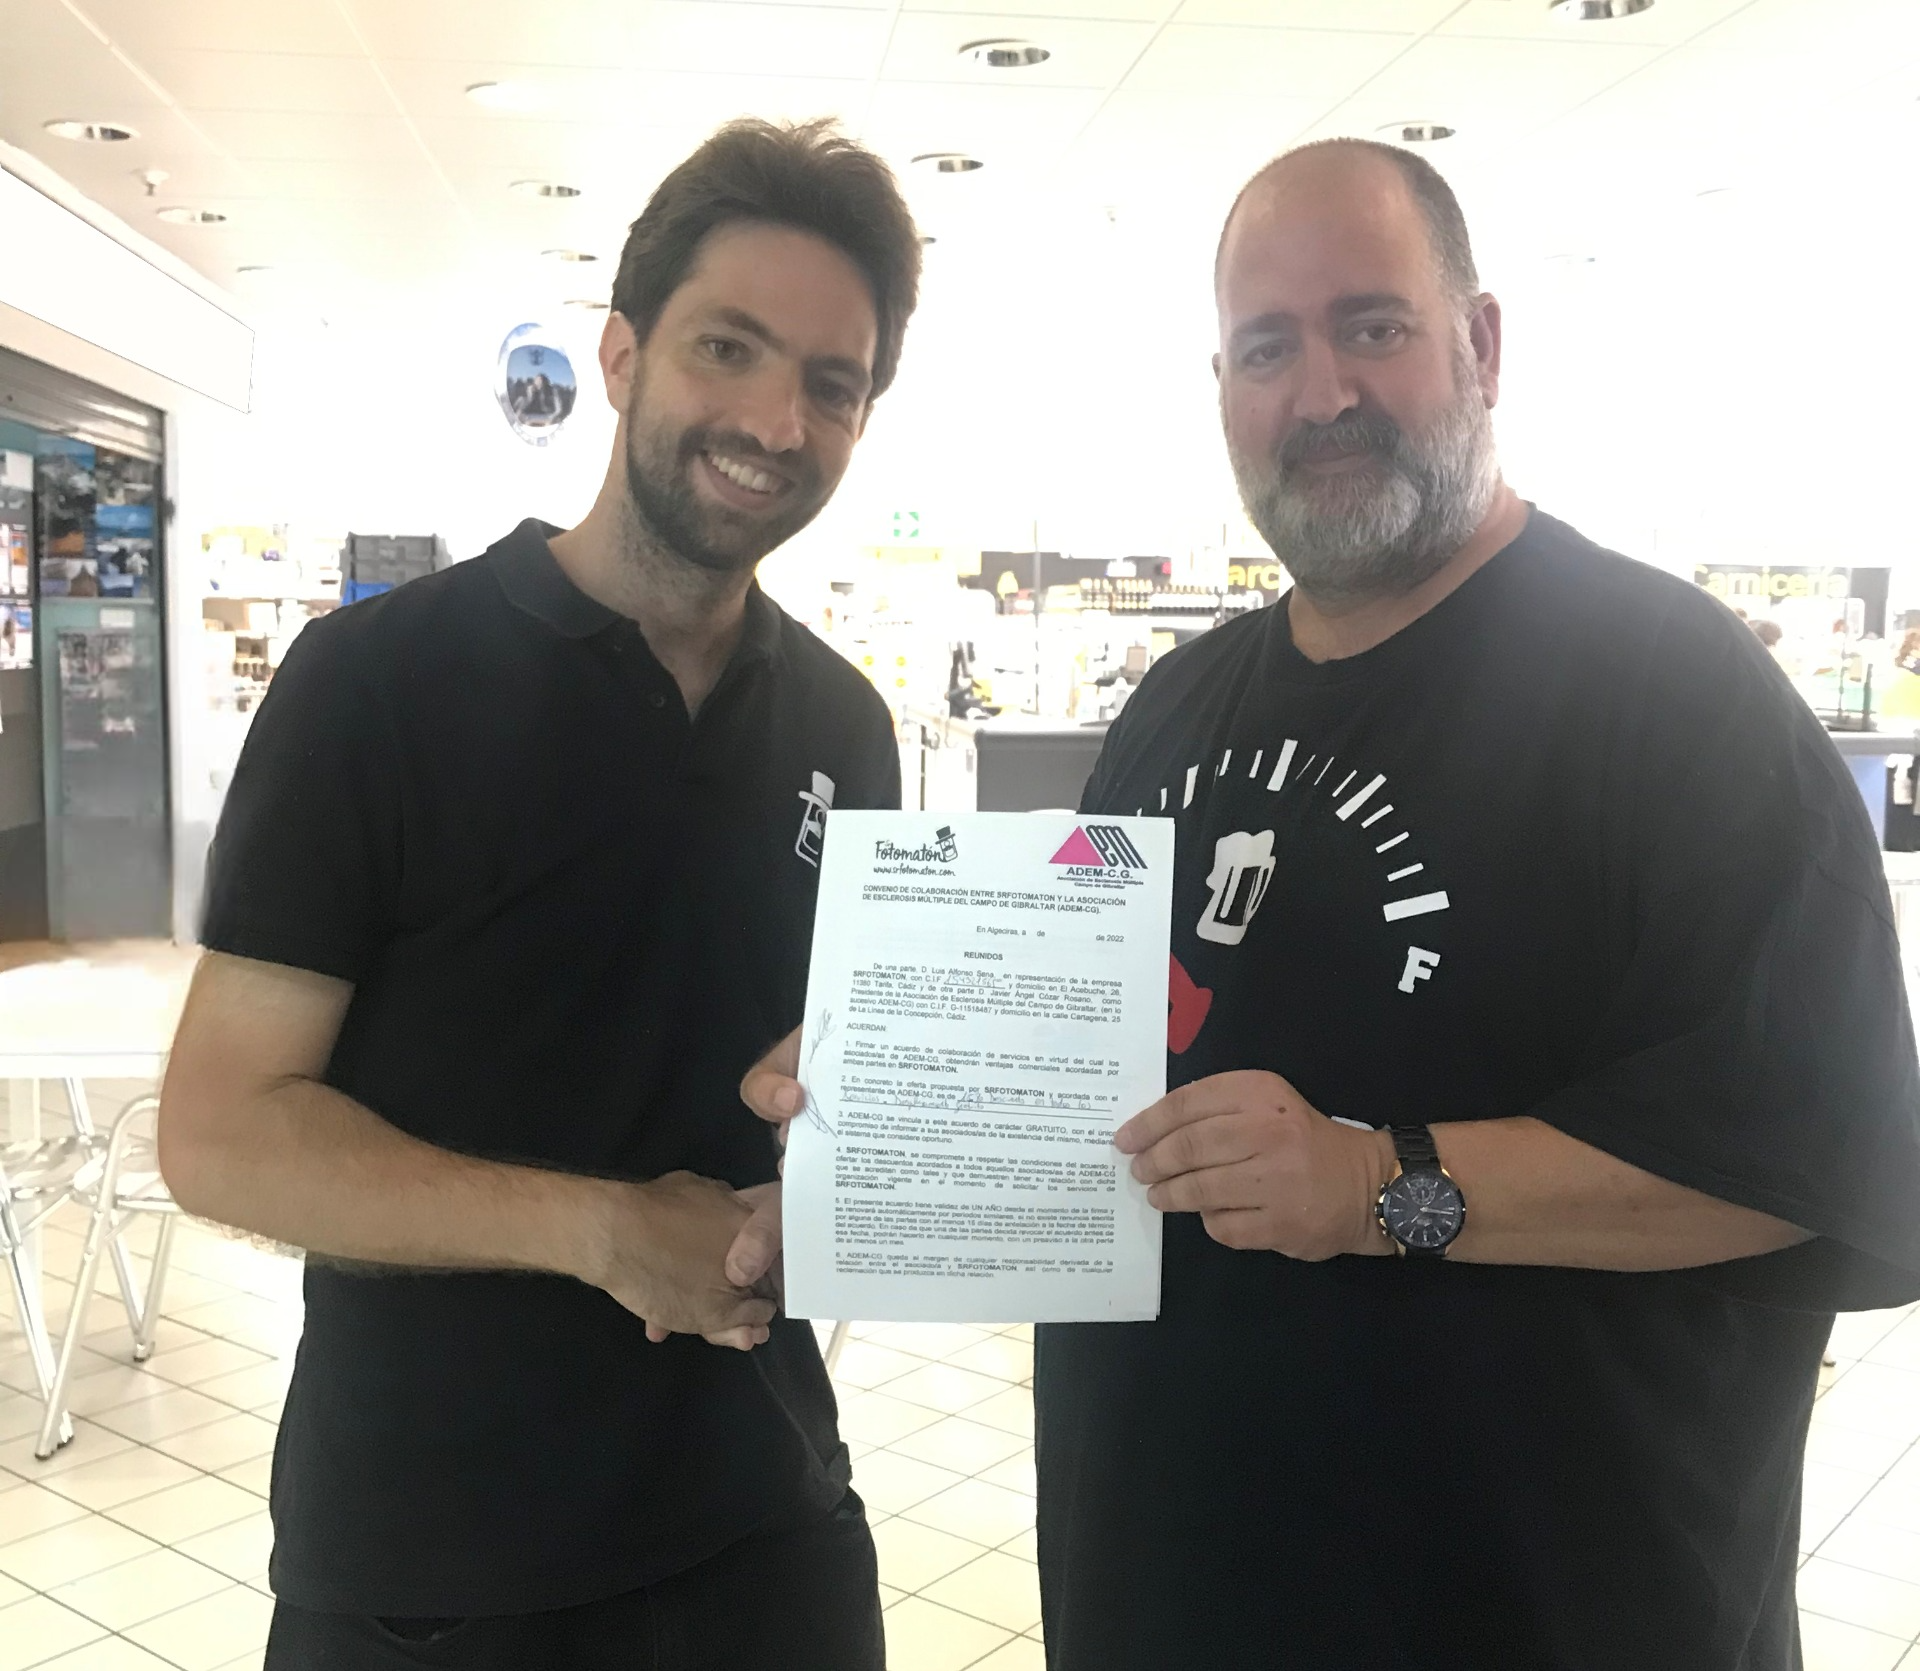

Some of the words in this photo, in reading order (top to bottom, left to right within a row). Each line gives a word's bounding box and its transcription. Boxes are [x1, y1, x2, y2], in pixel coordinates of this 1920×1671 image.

[876, 840, 943, 862] Fotomatón
[1066, 867, 1133, 879] ADEM-C.G.
[864, 885, 898, 893] CONVENIO
[911, 885, 968, 896] COLABORACIÓN
[970, 889, 994, 897] ENTRE
[997, 891, 1055, 901] SRFOTOMATON
[1077, 894, 1126, 905] ASOCIACIÓN
[873, 894, 916, 902] ESCLEROSIS
[917, 894, 952, 904] MÚLTIPLE
[970, 898, 997, 906] CAMPO
[1011, 900, 1055, 910] GIBRALTAR
[1057, 904, 1100, 915] (ADEM-CG).
[987, 927, 1020, 937] Algeciras,
[964, 951, 1003, 960] REUNIDOS
[1398, 946, 1441, 994] F
